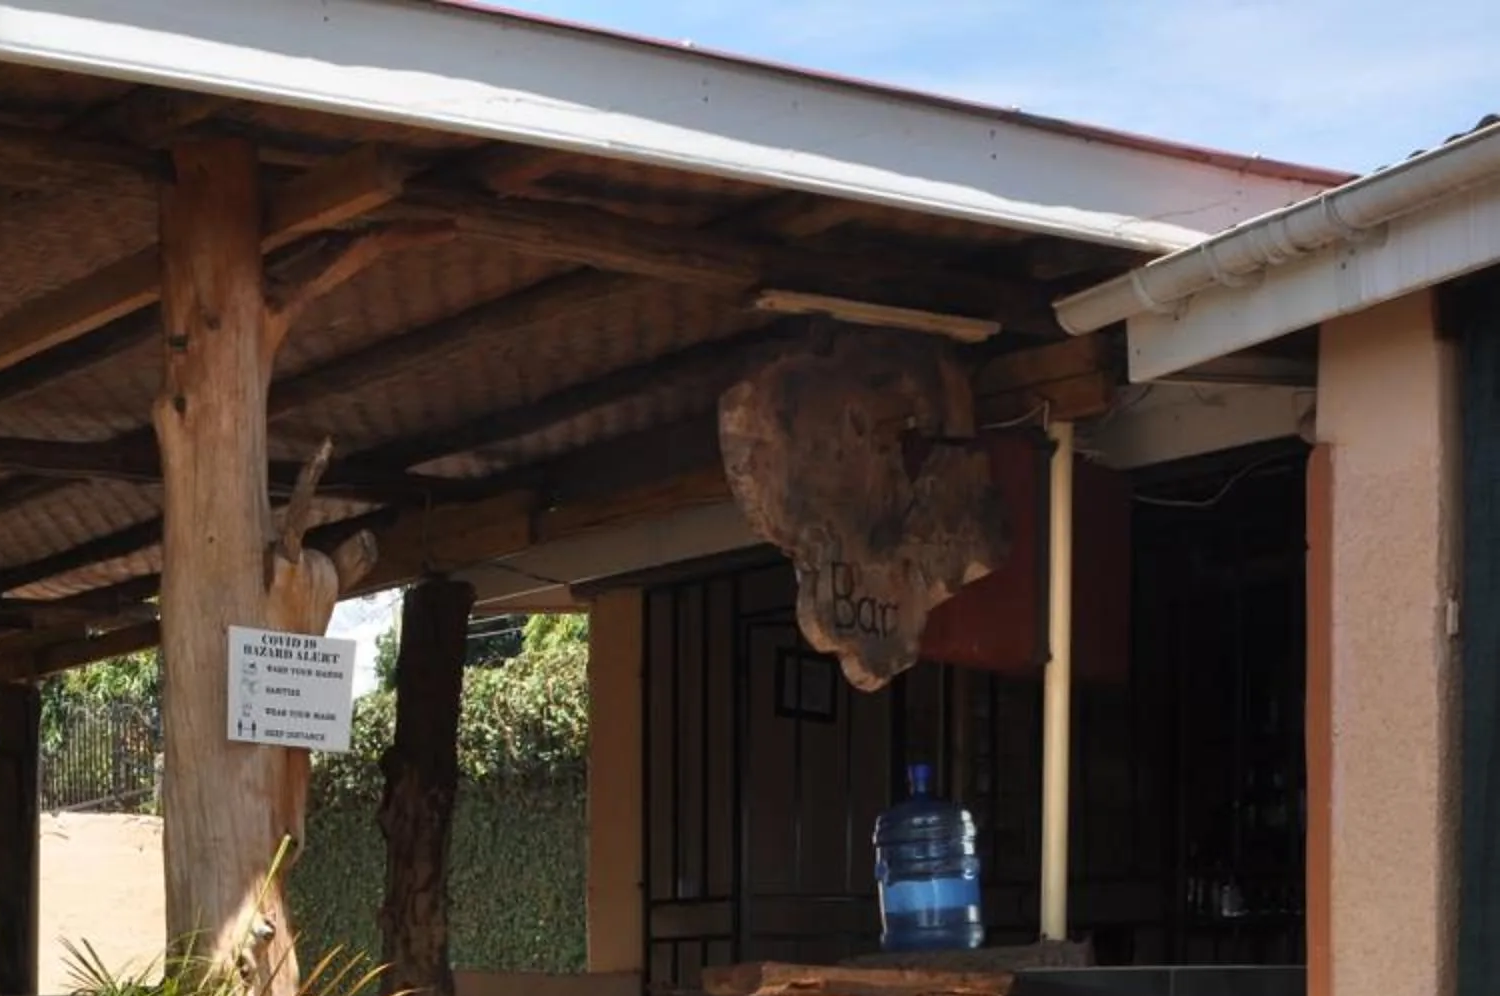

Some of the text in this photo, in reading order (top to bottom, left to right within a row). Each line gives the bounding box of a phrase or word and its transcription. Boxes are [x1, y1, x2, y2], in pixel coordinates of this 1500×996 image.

[831, 561, 898, 639] Bar
[261, 634, 317, 649] COVID 19
[243, 644, 340, 664] HAZARD ALERT
[291, 667, 312, 677] YOUR
